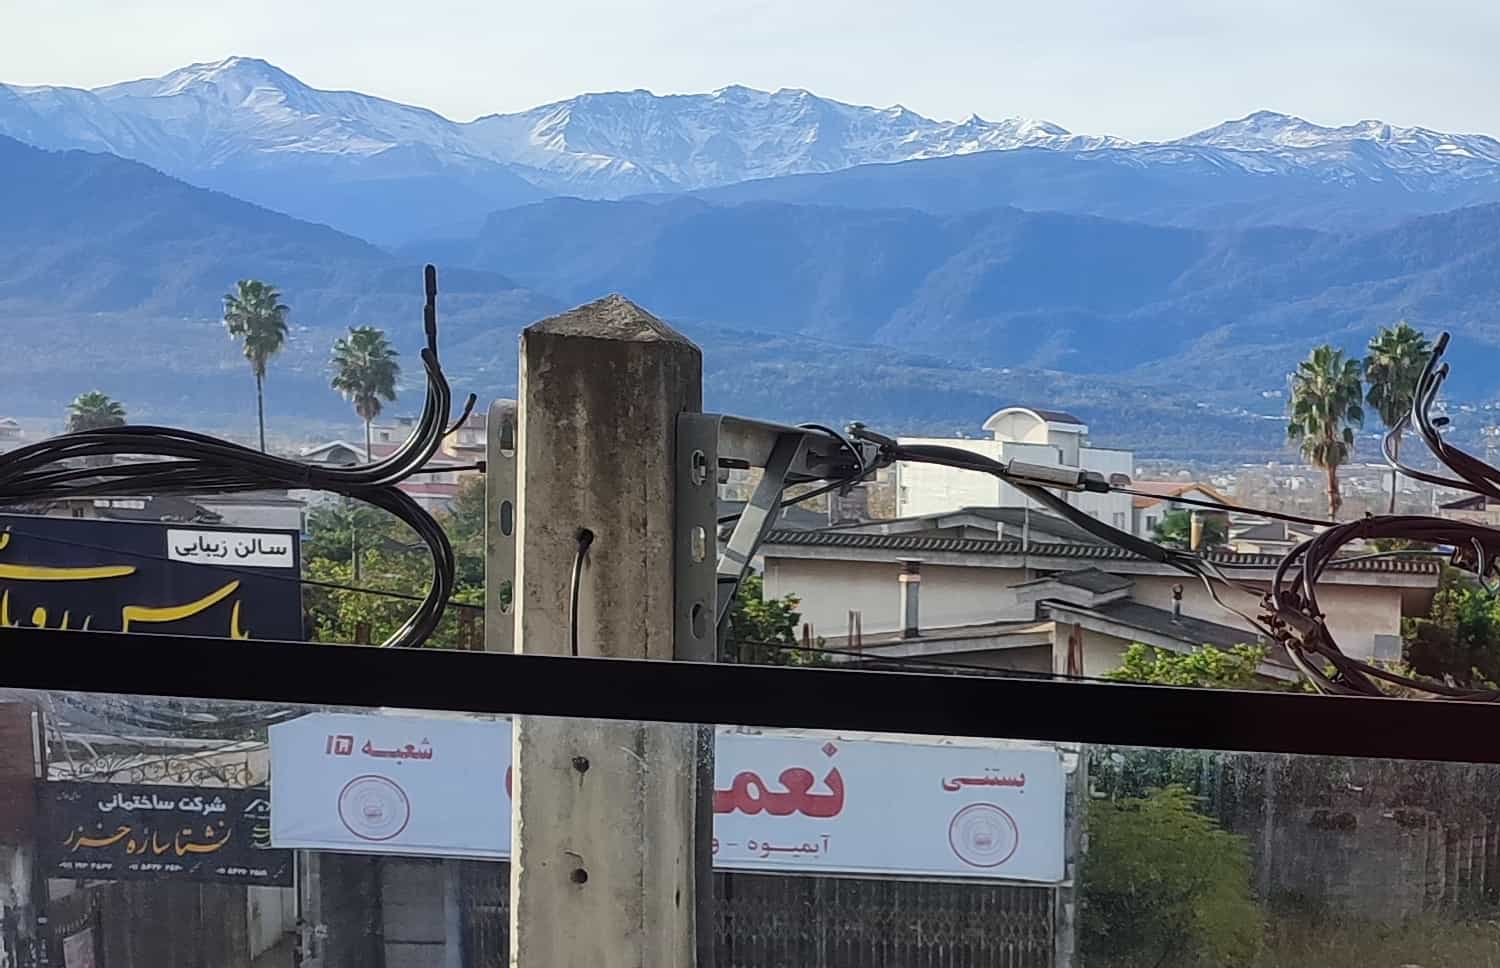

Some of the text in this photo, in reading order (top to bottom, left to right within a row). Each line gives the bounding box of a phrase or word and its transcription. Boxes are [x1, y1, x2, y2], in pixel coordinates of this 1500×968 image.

[174, 535, 287, 558] سالن زیبایی
[361, 736, 433, 766] شعبه
[712, 742, 845, 818] نعم
[942, 766, 1025, 795] بستنی
[98, 791, 175, 812] ساختمانی
[178, 796, 227, 816] شرکت
[746, 833, 831, 859] آبمیوه
